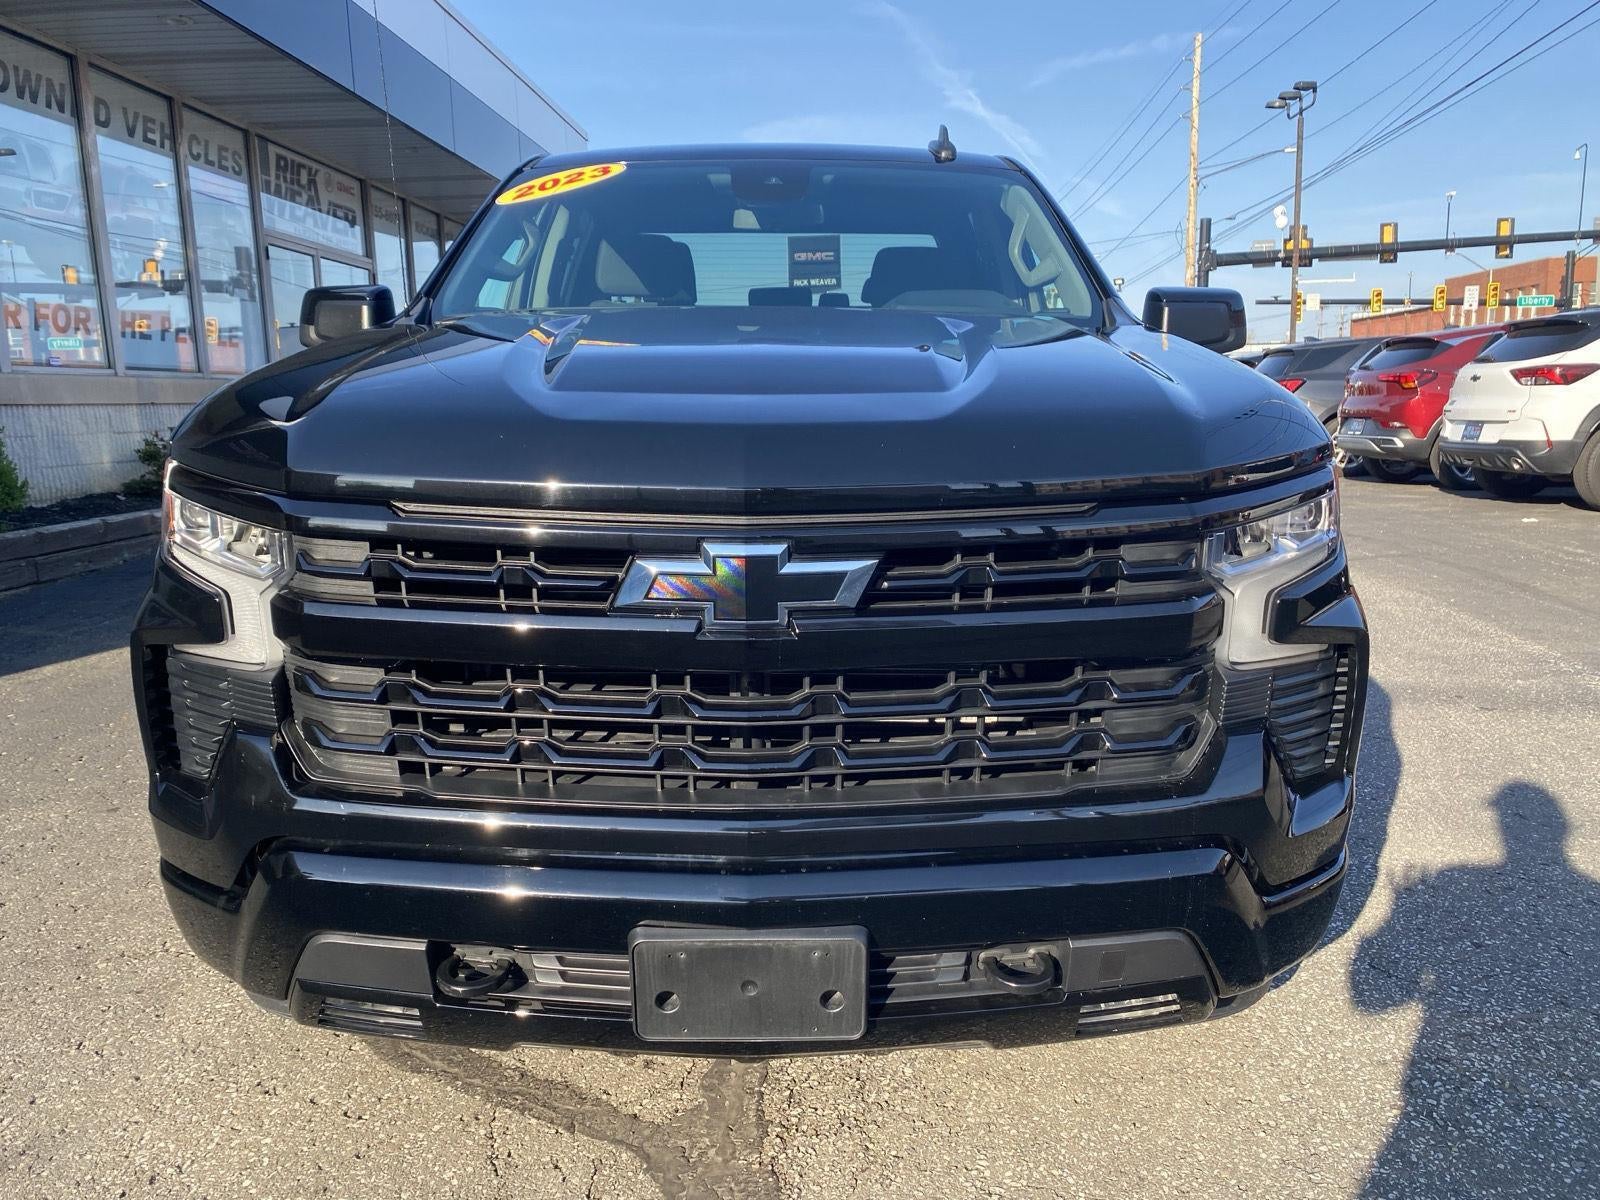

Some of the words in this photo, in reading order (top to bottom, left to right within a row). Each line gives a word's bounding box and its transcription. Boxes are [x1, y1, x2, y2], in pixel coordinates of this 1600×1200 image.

[121, 106, 244, 176] VEHCLES
[275, 152, 321, 194] RICK
[512, 165, 612, 200] 2023
[794, 251, 834, 261] GMC
[793, 279, 809, 287] RICK
[810, 278, 837, 286] WEAVER
[1521, 296, 1550, 306] Liberty
[33, 302, 92, 336] FOR
